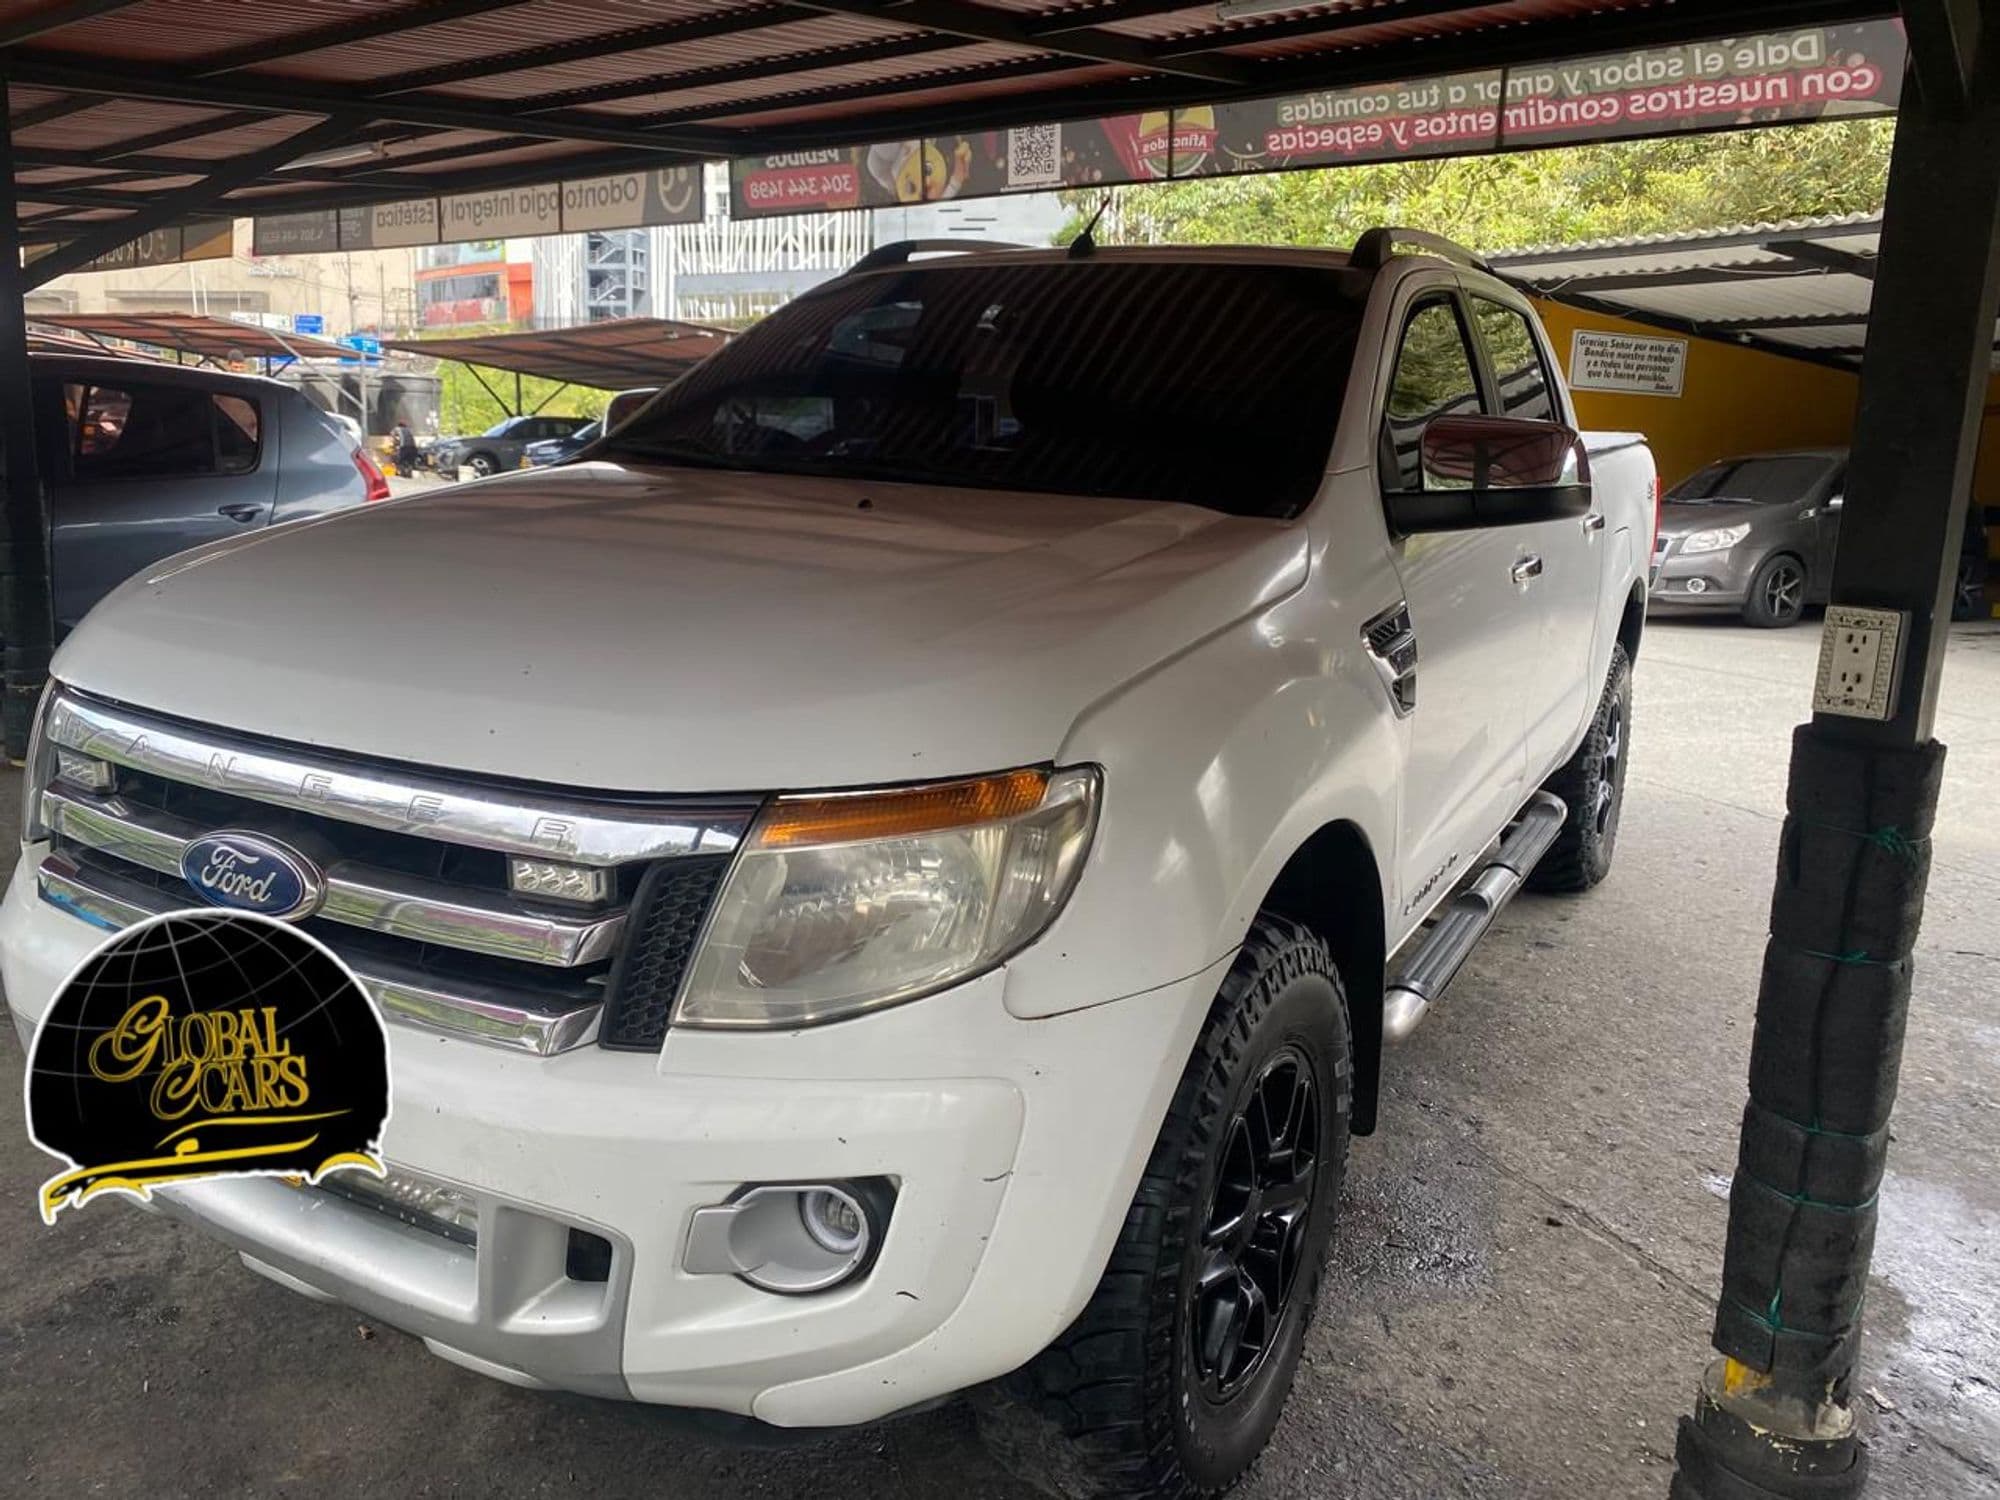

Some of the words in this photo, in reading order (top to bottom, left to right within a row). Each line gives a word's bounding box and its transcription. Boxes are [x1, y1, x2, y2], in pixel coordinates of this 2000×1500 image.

[1579, 336, 1608, 348] Gracias
[1633, 343, 1648, 352] por
[63, 709, 577, 846] RANGER
[201, 845, 278, 903] Ford
